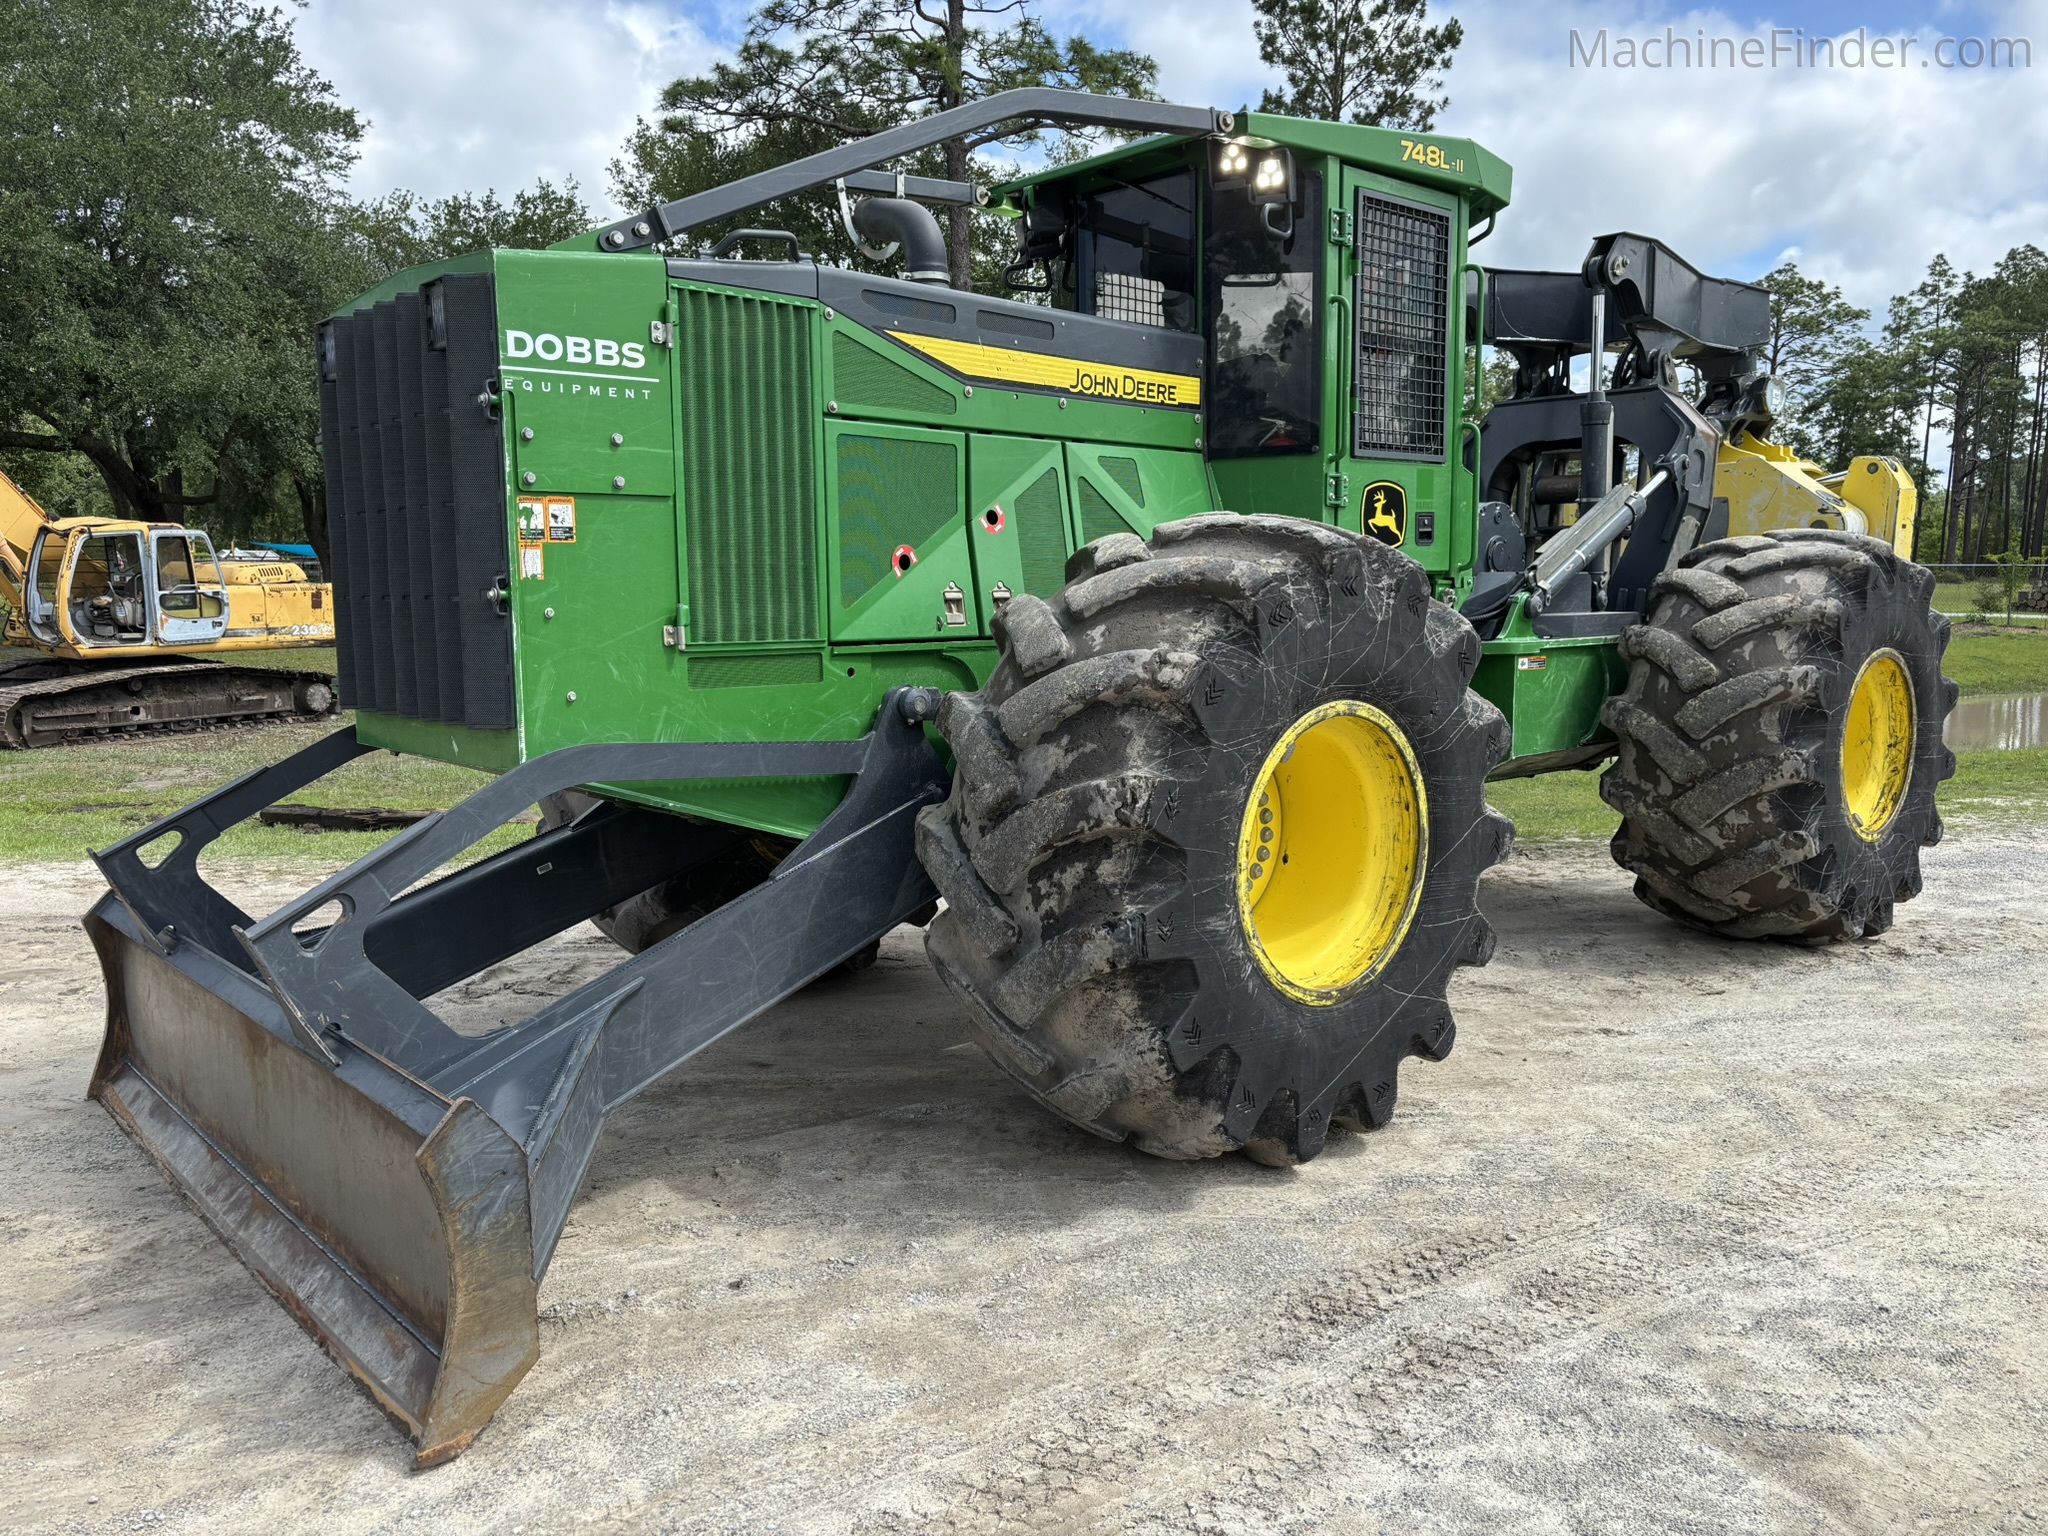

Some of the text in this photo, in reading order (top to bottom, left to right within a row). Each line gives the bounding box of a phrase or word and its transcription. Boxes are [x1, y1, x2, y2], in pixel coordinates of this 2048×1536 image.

[1400, 139, 1464, 172] 748L-II
[505, 329, 646, 369] DOBBS
[503, 378, 651, 400] EQUIPMENT
[1069, 368, 1178, 402] JOHN DEERE
